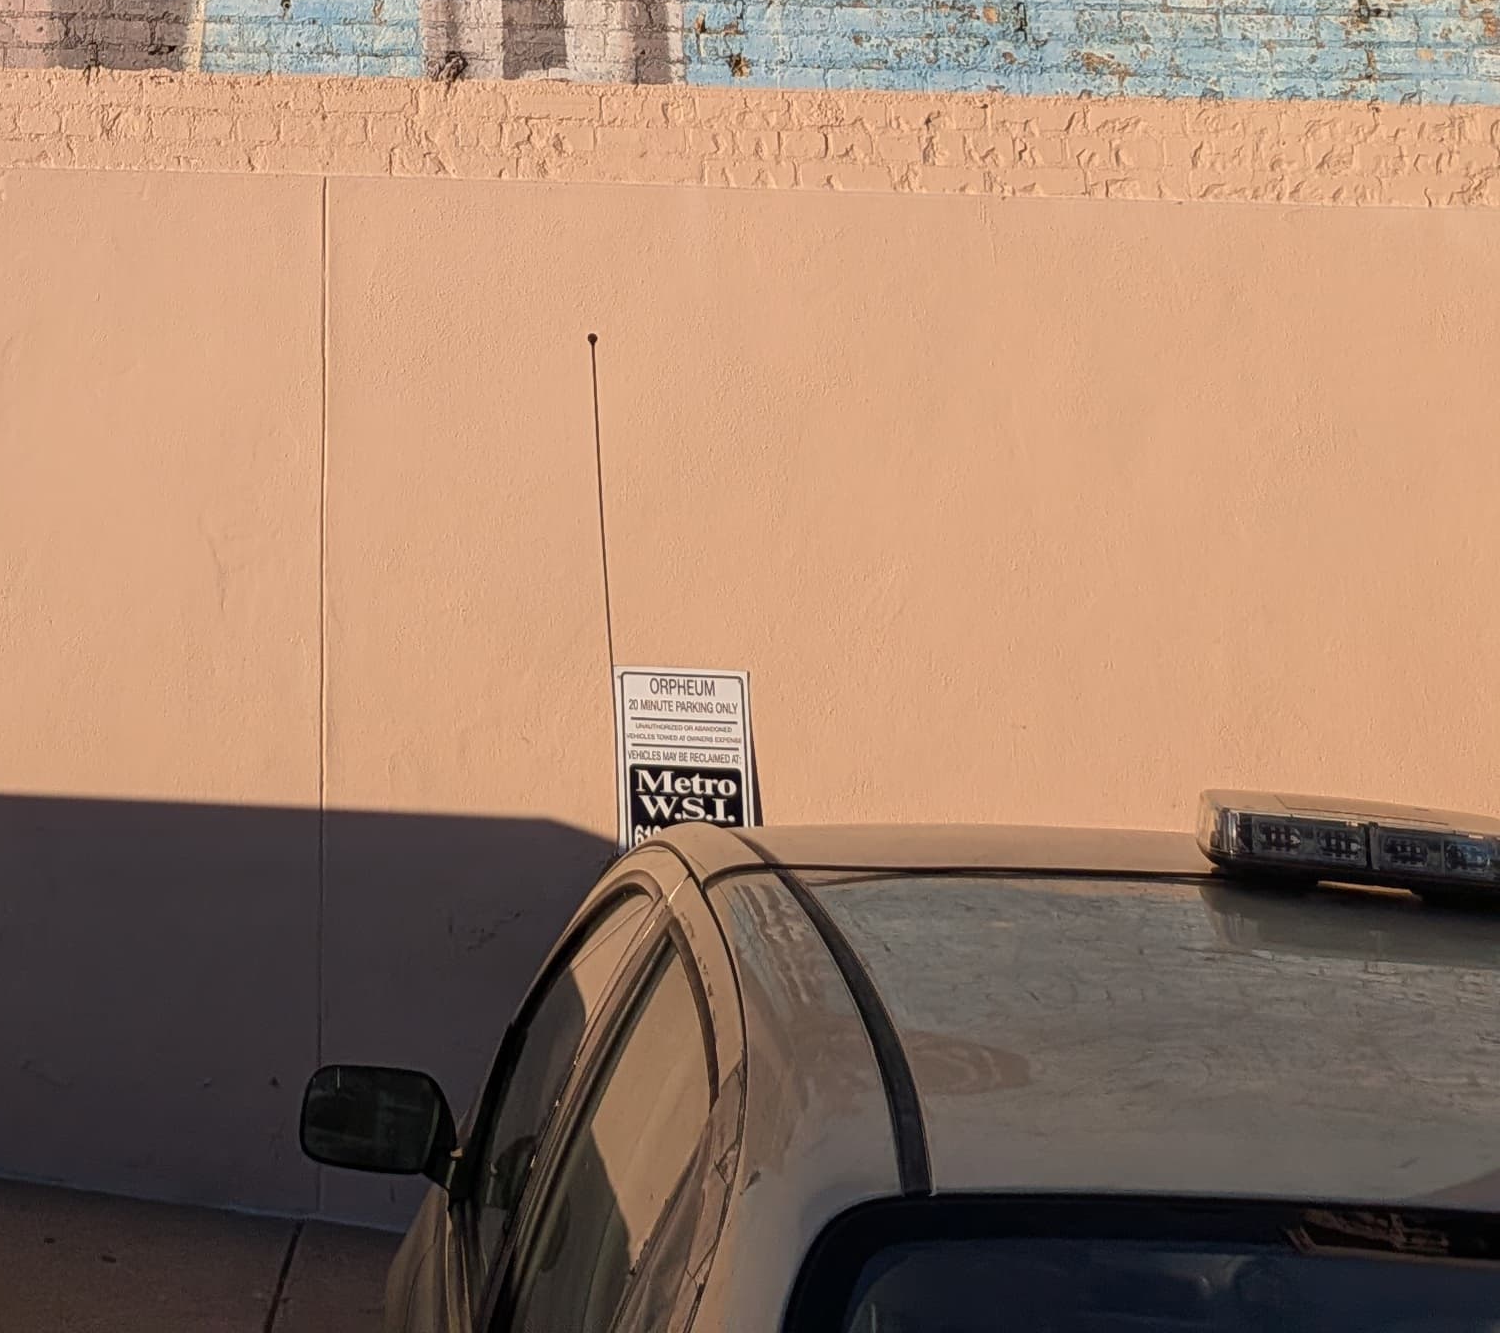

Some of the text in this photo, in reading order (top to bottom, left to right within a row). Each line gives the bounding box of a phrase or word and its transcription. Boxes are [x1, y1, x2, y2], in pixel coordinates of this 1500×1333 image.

[649, 677, 716, 697] ORPHEUM
[628, 698, 738, 714] 20 MINUTE PARKING ONLY
[627, 733, 655, 741] VEHICLES
[628, 749, 662, 761] VEHICLES
[662, 751, 677, 762] MAY
[678, 752, 688, 762] BE
[689, 752, 731, 764] RECLAIMED
[635, 769, 737, 796] Metro
[638, 795, 736, 822] W.S.I.
